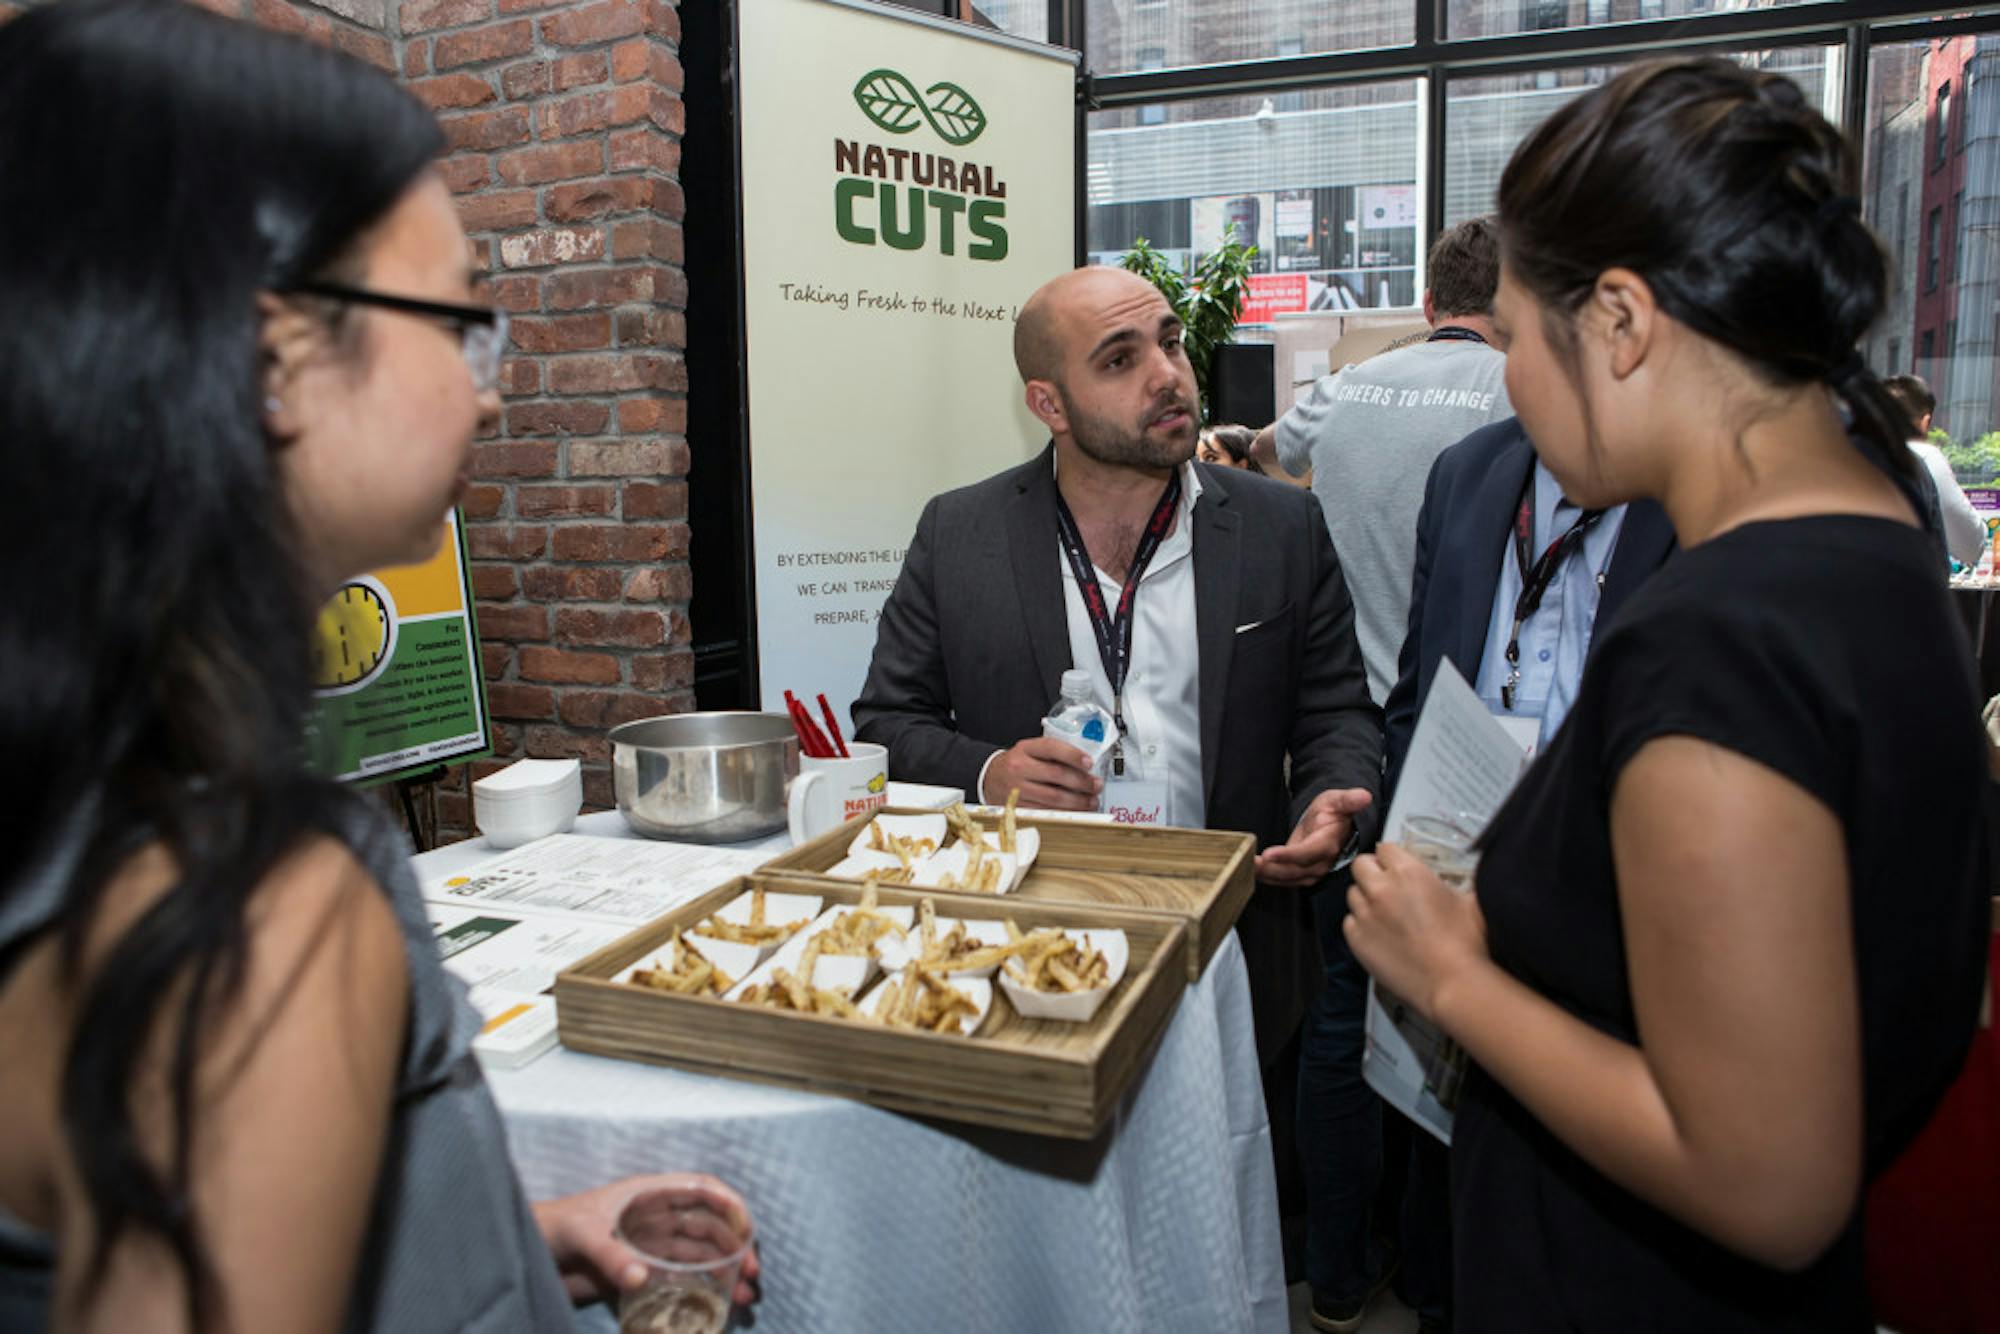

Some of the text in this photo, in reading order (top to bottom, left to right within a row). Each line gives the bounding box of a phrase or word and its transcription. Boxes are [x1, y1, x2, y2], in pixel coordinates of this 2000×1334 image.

[835, 138, 1006, 198] NATURAL
[835, 178, 1008, 262] CUTS
[780, 283, 849, 310] Taking
[857, 290, 906, 311] Fresh
[911, 296, 927, 313] to
[932, 298, 957, 316] the
[963, 301, 1006, 321] Next
[1338, 384, 1493, 411] CHEERS TO CHANGE
[777, 554, 794, 567] BY
[797, 551, 866, 566] EXTENDING
[868, 550, 891, 563] THE
[798, 583, 817, 596] WE
[822, 582, 847, 595] CAN
[814, 610, 869, 624] PREPARE,
